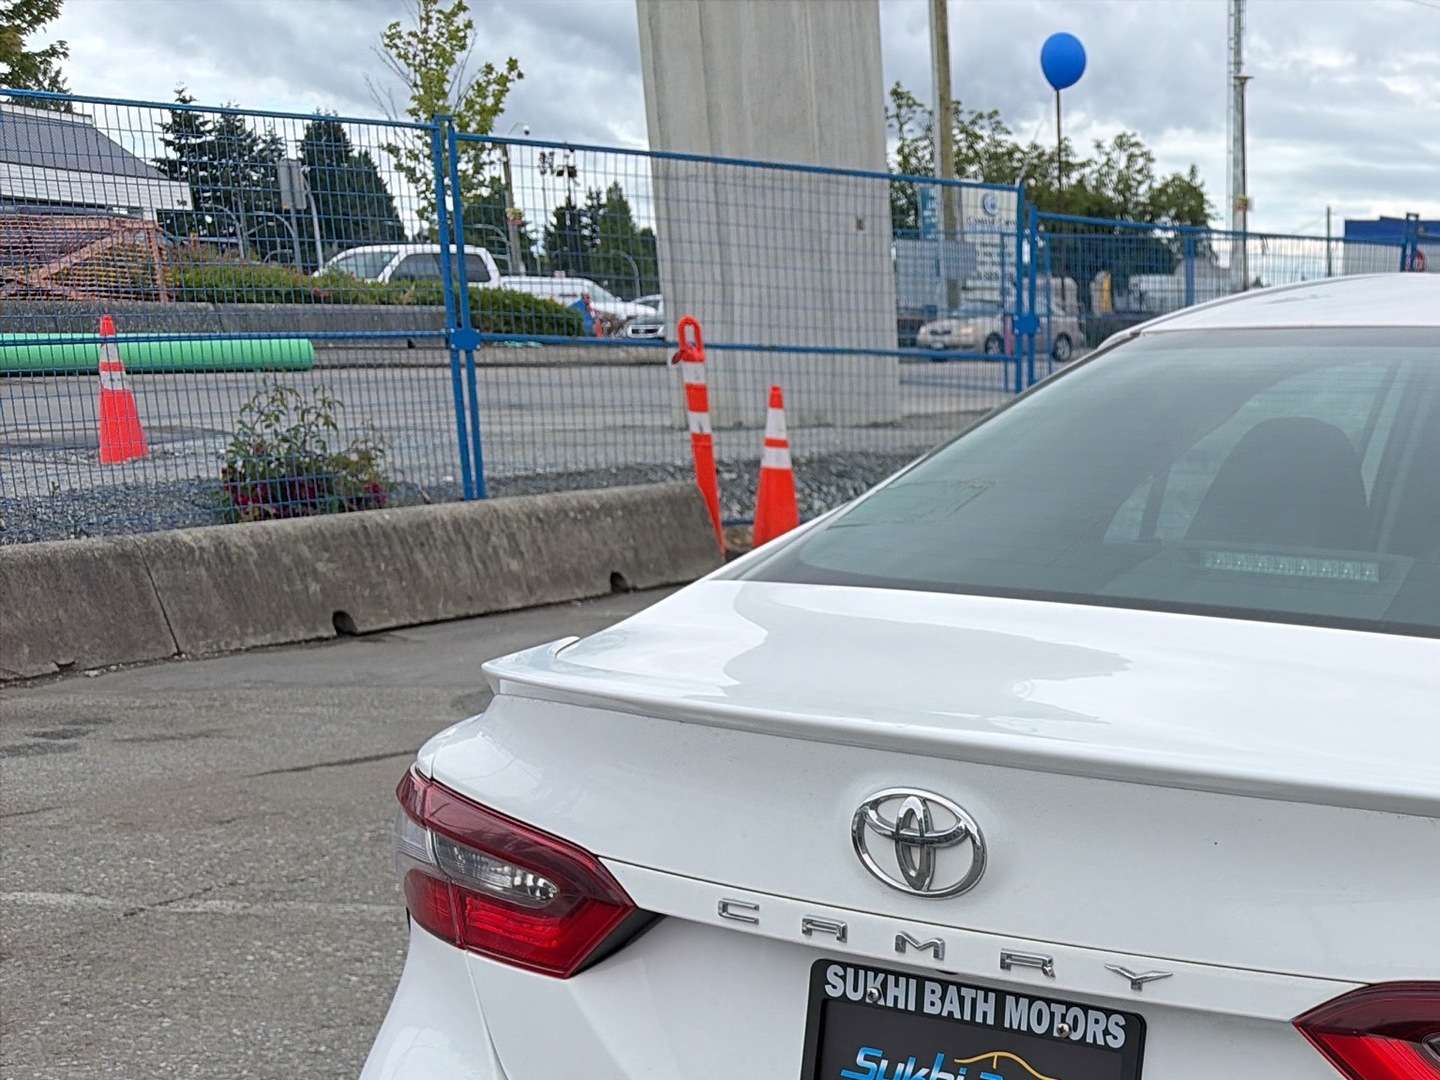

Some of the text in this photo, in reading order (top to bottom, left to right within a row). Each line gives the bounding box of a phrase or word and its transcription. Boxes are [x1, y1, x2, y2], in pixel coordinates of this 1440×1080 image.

[717, 897, 1174, 991] CAMRY
[824, 964, 1127, 1049] SUKHI BATH MOTORS
